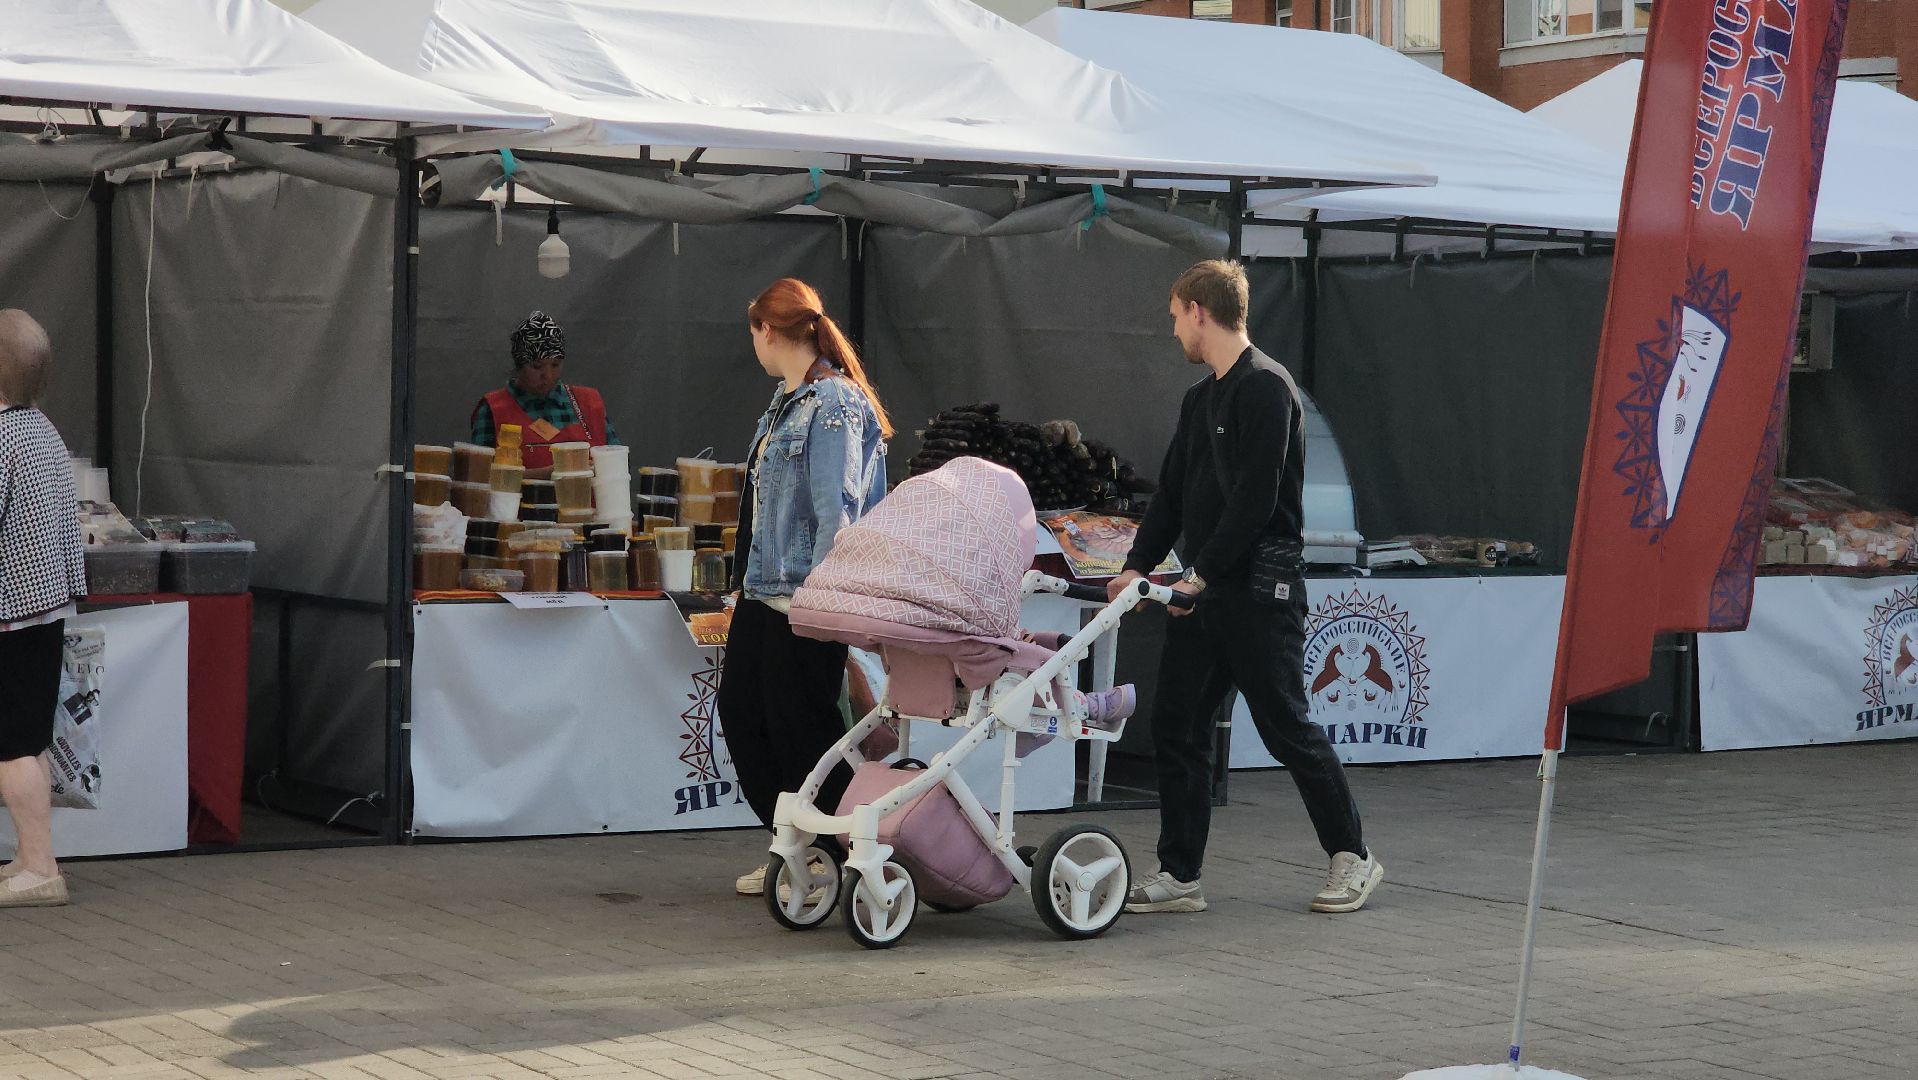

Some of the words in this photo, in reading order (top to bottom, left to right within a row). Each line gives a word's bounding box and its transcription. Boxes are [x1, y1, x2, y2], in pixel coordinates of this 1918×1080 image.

[1303, 620, 1405, 676] ВСЕРОССИЙСКИЕ
[1855, 703, 1918, 732] ЯРМ
[673, 780, 744, 815] ЯР
